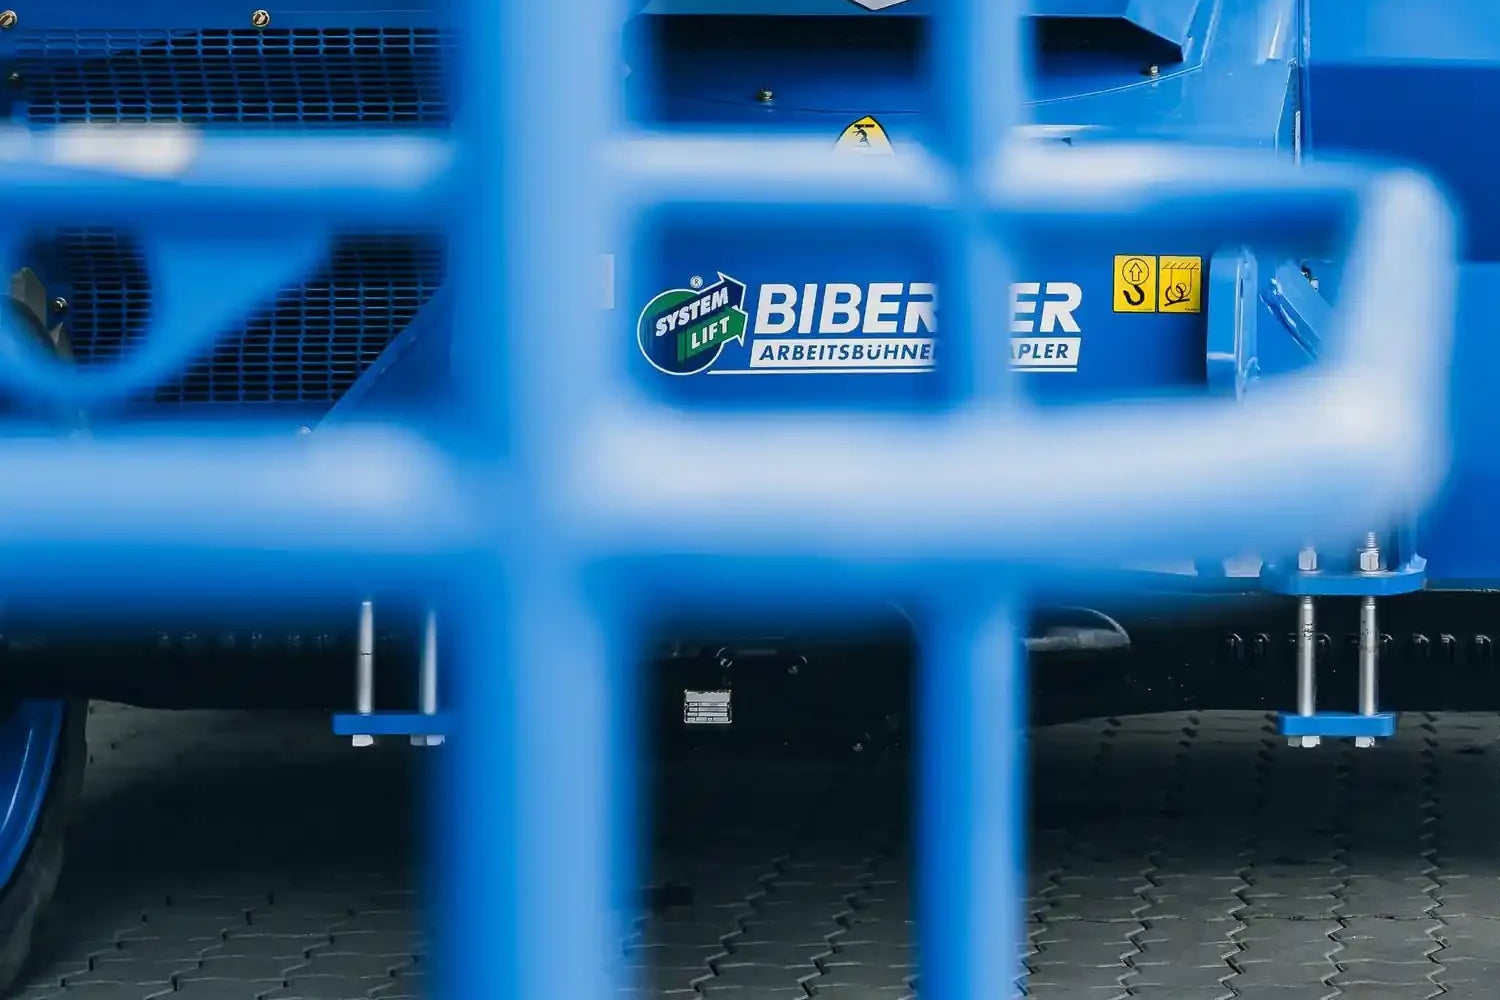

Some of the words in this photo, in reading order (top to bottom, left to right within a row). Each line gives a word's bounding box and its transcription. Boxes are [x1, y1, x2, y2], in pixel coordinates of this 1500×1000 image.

[655, 286, 729, 337] SYSTEM
[753, 282, 1083, 334] BIBERER
[691, 315, 730, 350] LIFT
[758, 343, 937, 361] ARBEITSBÜHNE
